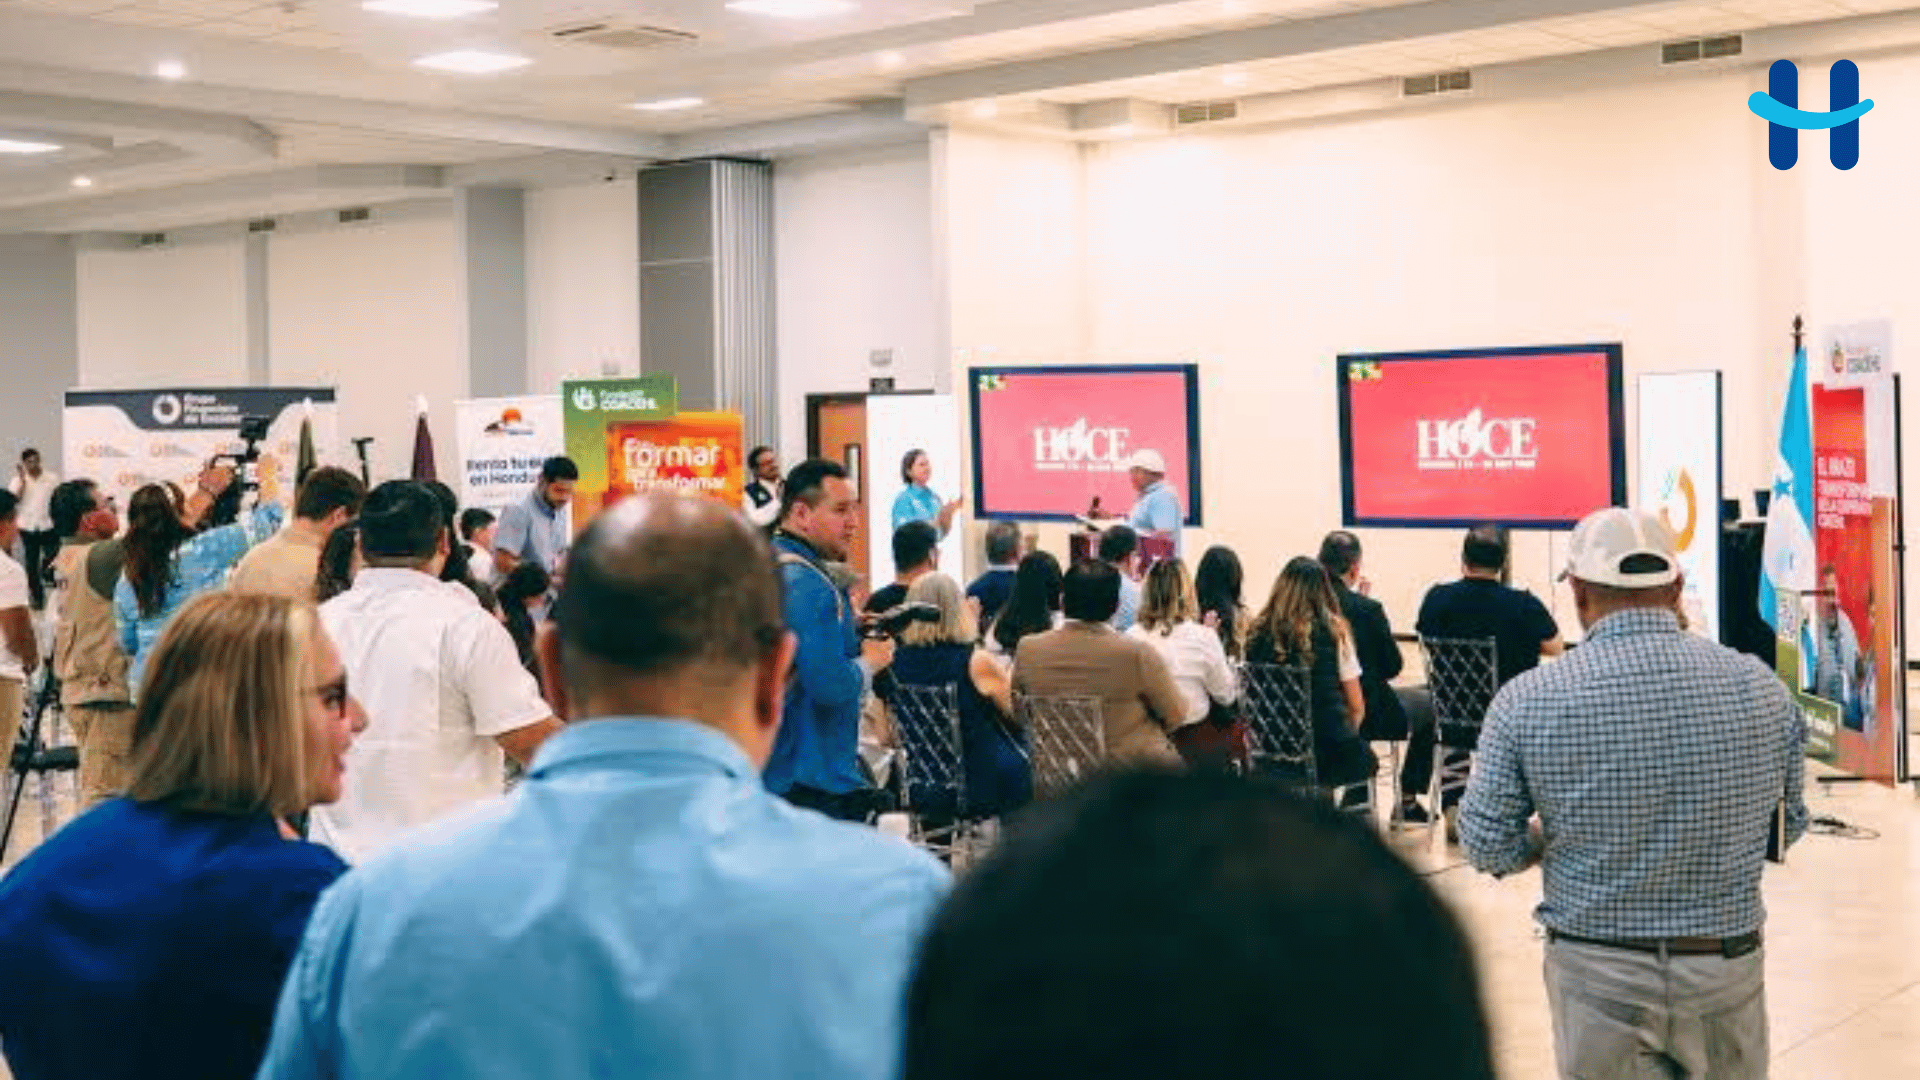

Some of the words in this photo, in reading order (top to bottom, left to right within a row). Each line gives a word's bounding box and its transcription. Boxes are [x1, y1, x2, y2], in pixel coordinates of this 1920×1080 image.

[623, 439, 721, 466] formar
[469, 474, 488, 486] en
[489, 472, 537, 485] Hondu
